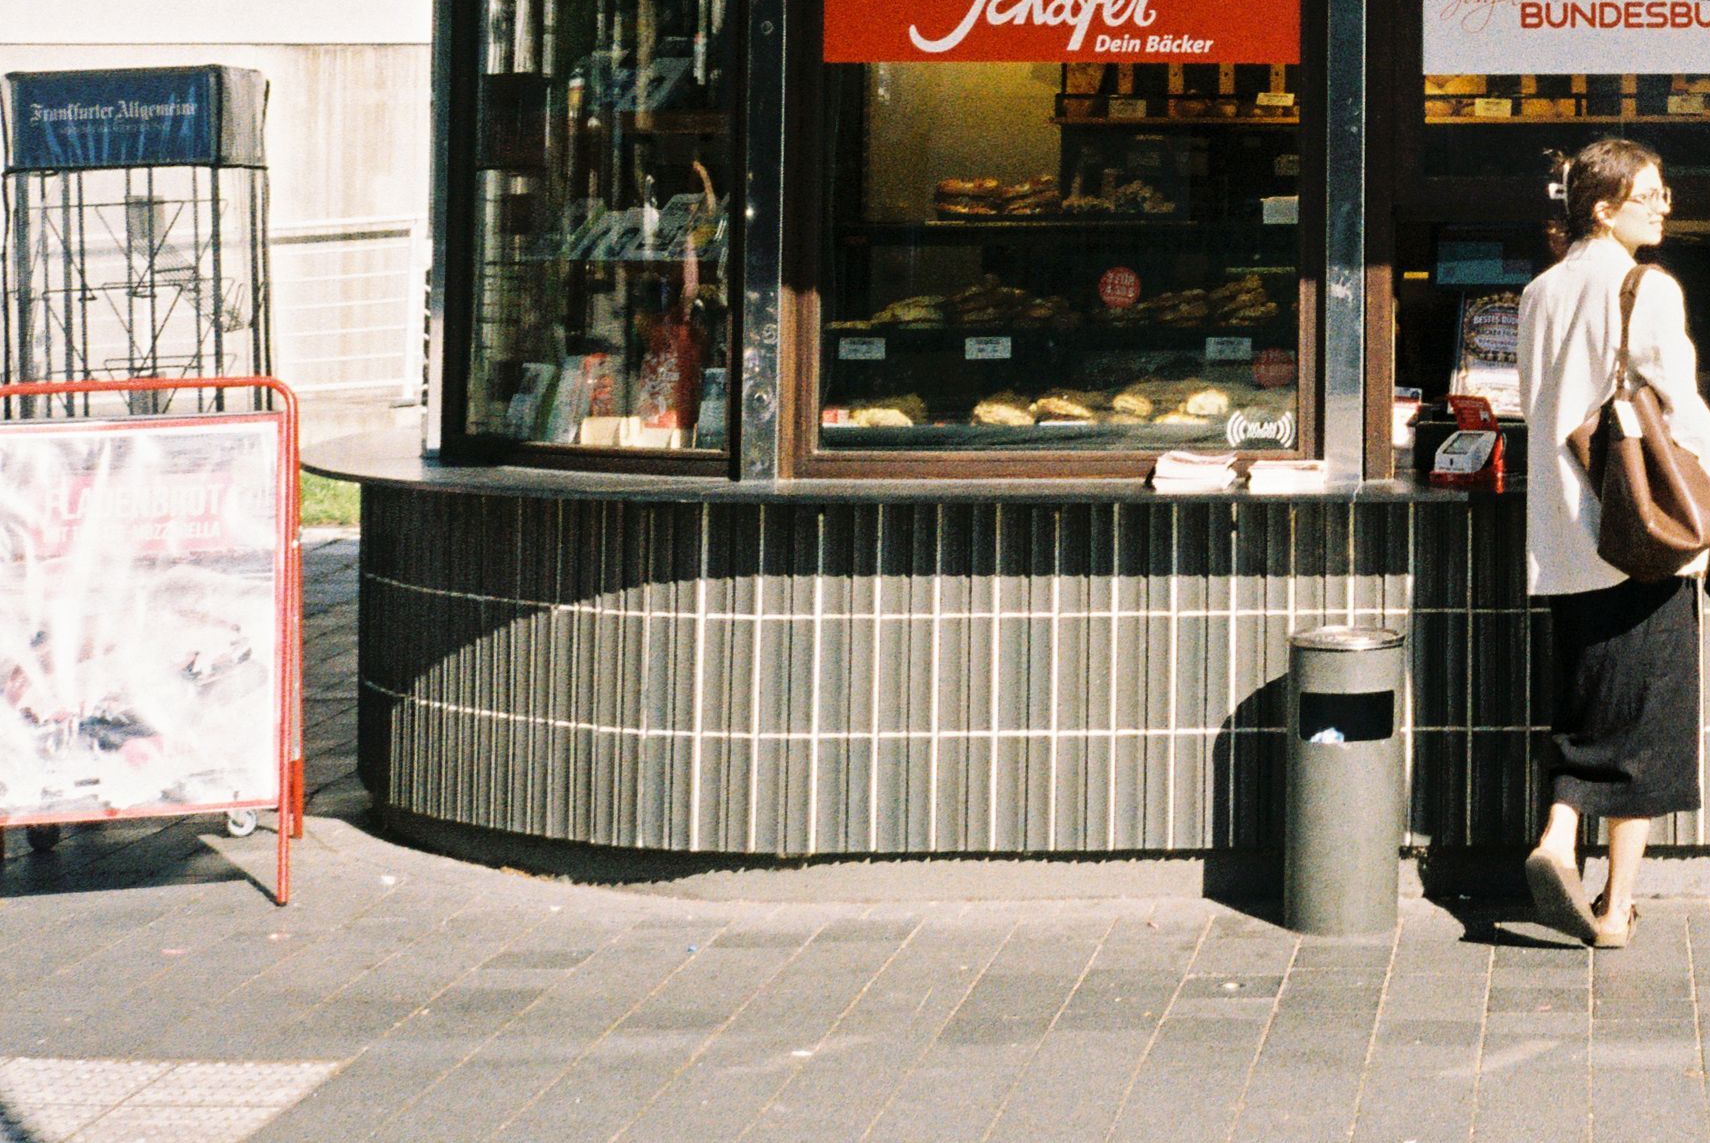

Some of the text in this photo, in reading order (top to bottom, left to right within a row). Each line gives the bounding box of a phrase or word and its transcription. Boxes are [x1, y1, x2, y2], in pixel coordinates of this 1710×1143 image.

[1095, 34, 1214, 54] Dein Bäcker
[29, 100, 114, 127] Frankfurter
